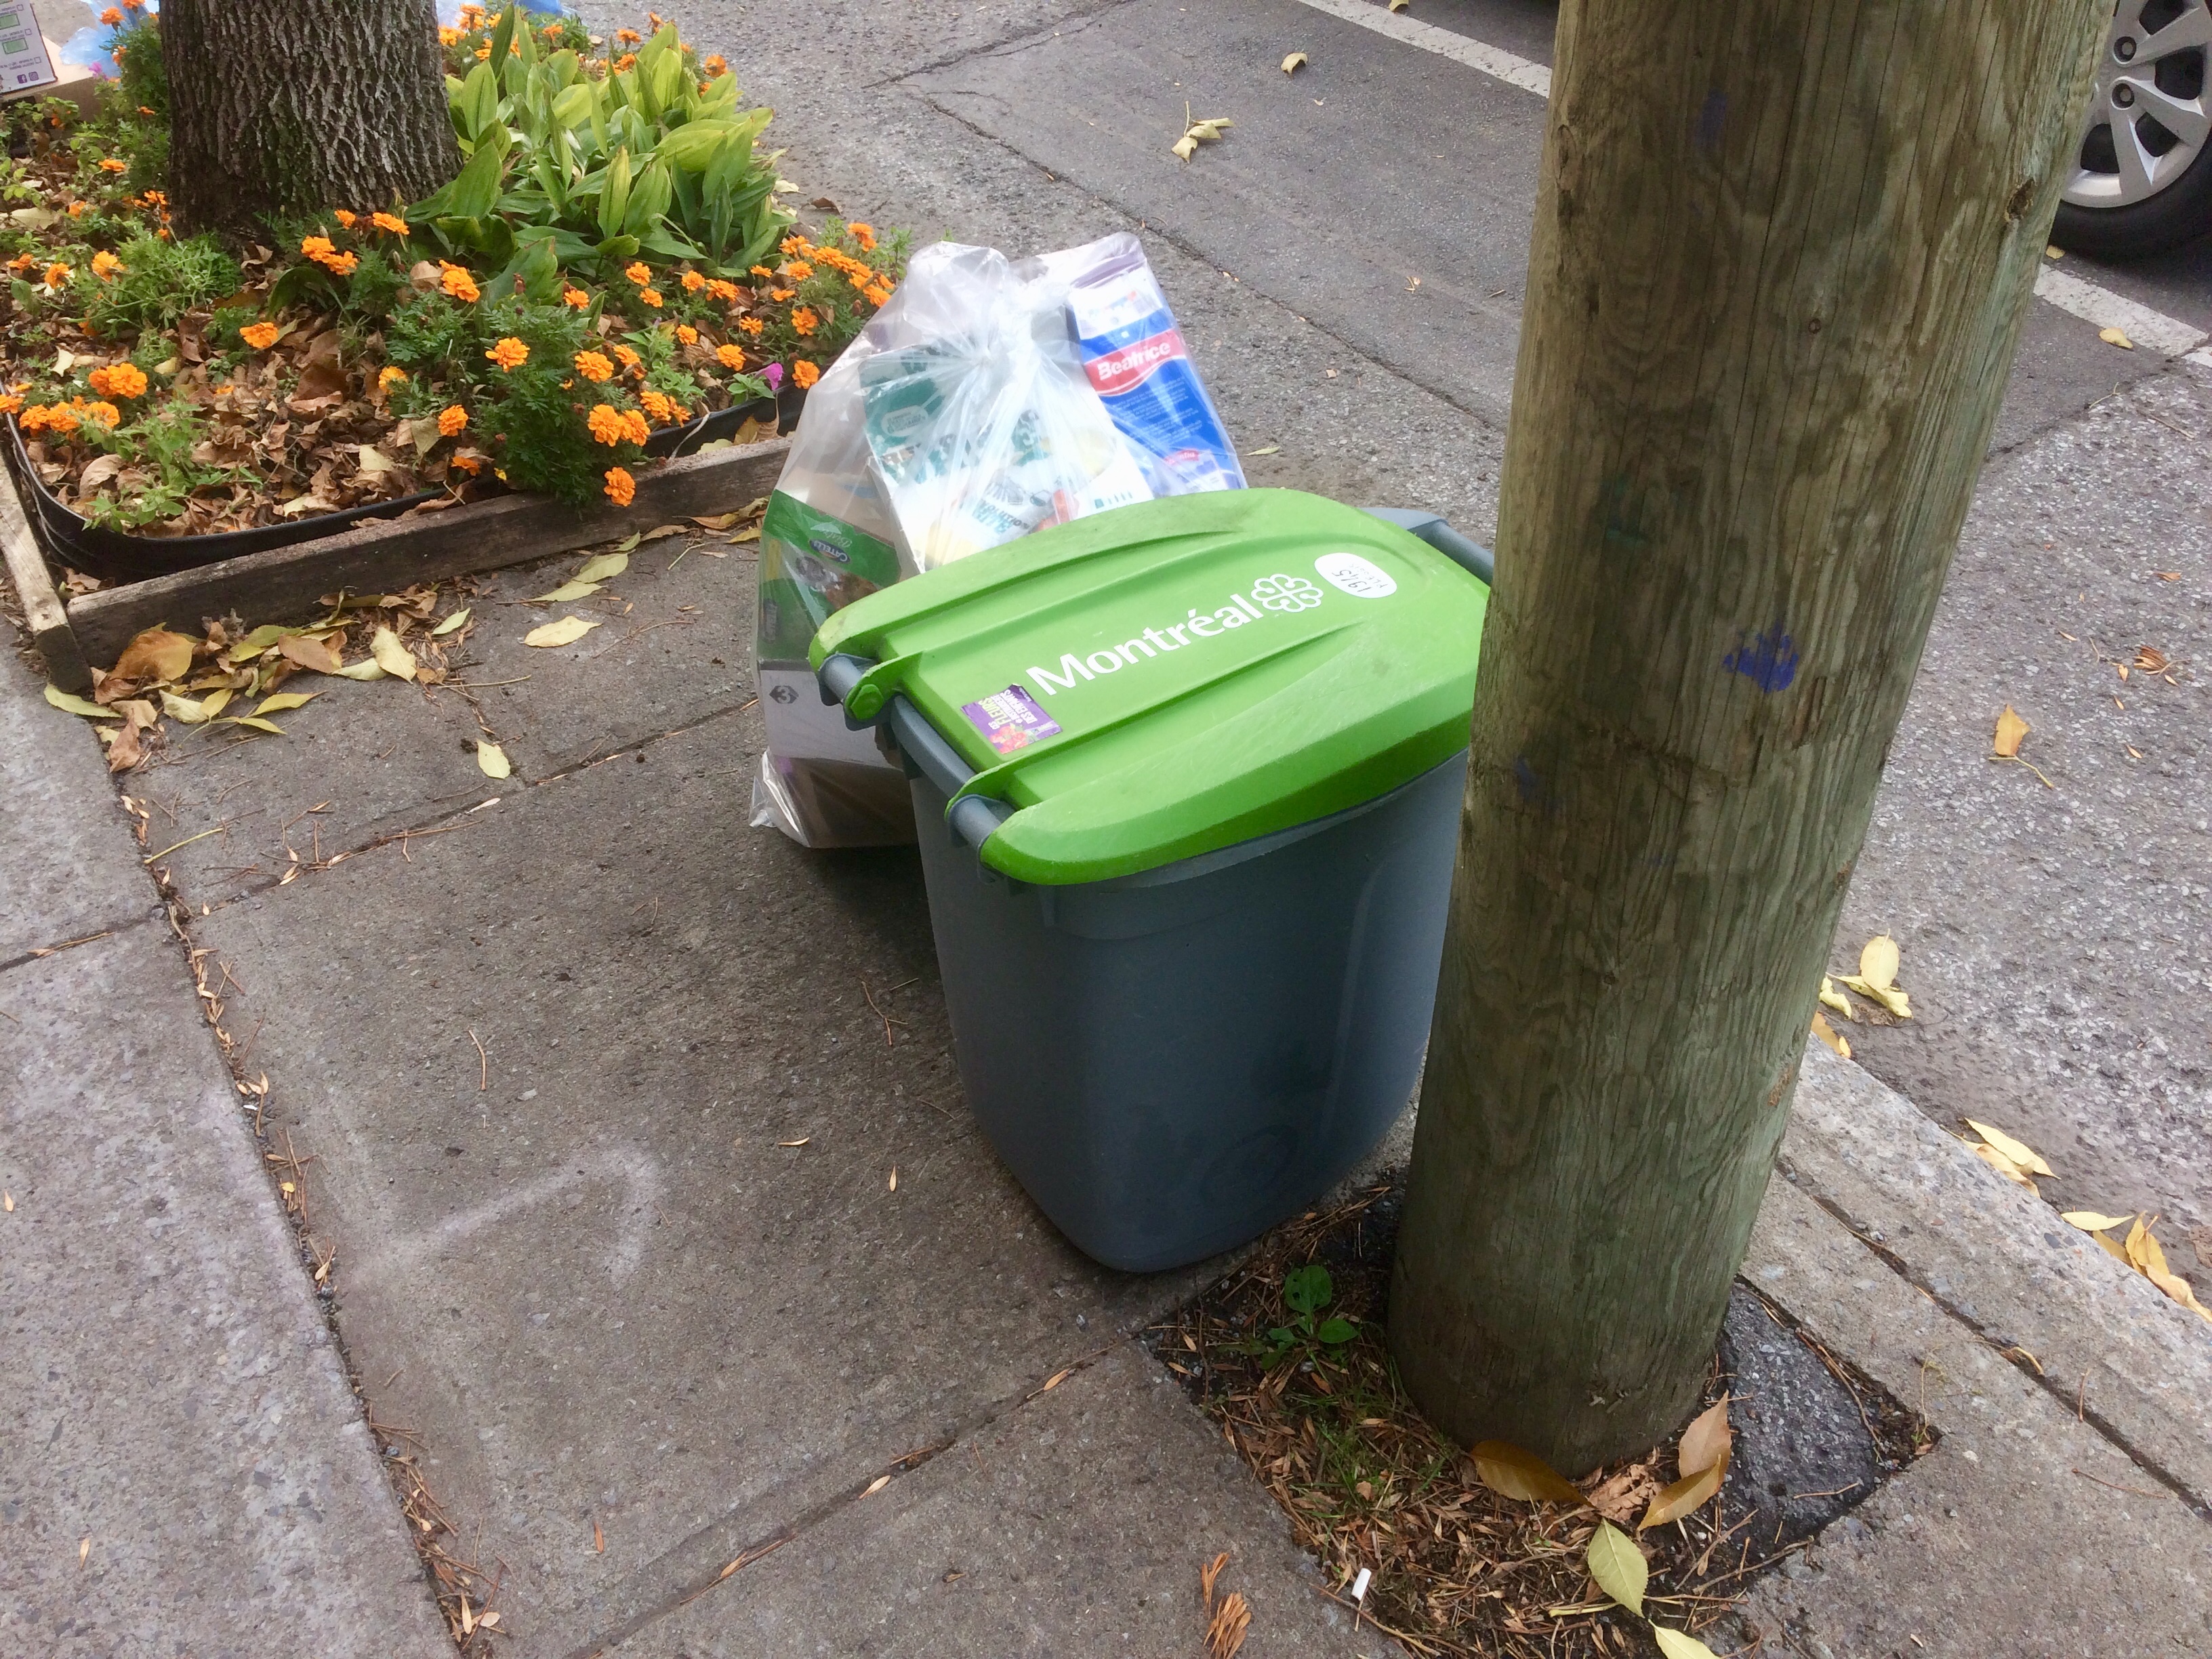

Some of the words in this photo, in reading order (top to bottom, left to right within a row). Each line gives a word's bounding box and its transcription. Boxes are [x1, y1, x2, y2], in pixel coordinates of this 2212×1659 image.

[1097, 342, 1171, 381] Beatrice
[822, 529, 853, 548] Bistr
[1026, 594, 1264, 696] Montréal
[979, 697, 1012, 725] FLEURS
[1000, 689, 1028, 714] ENFANTS
